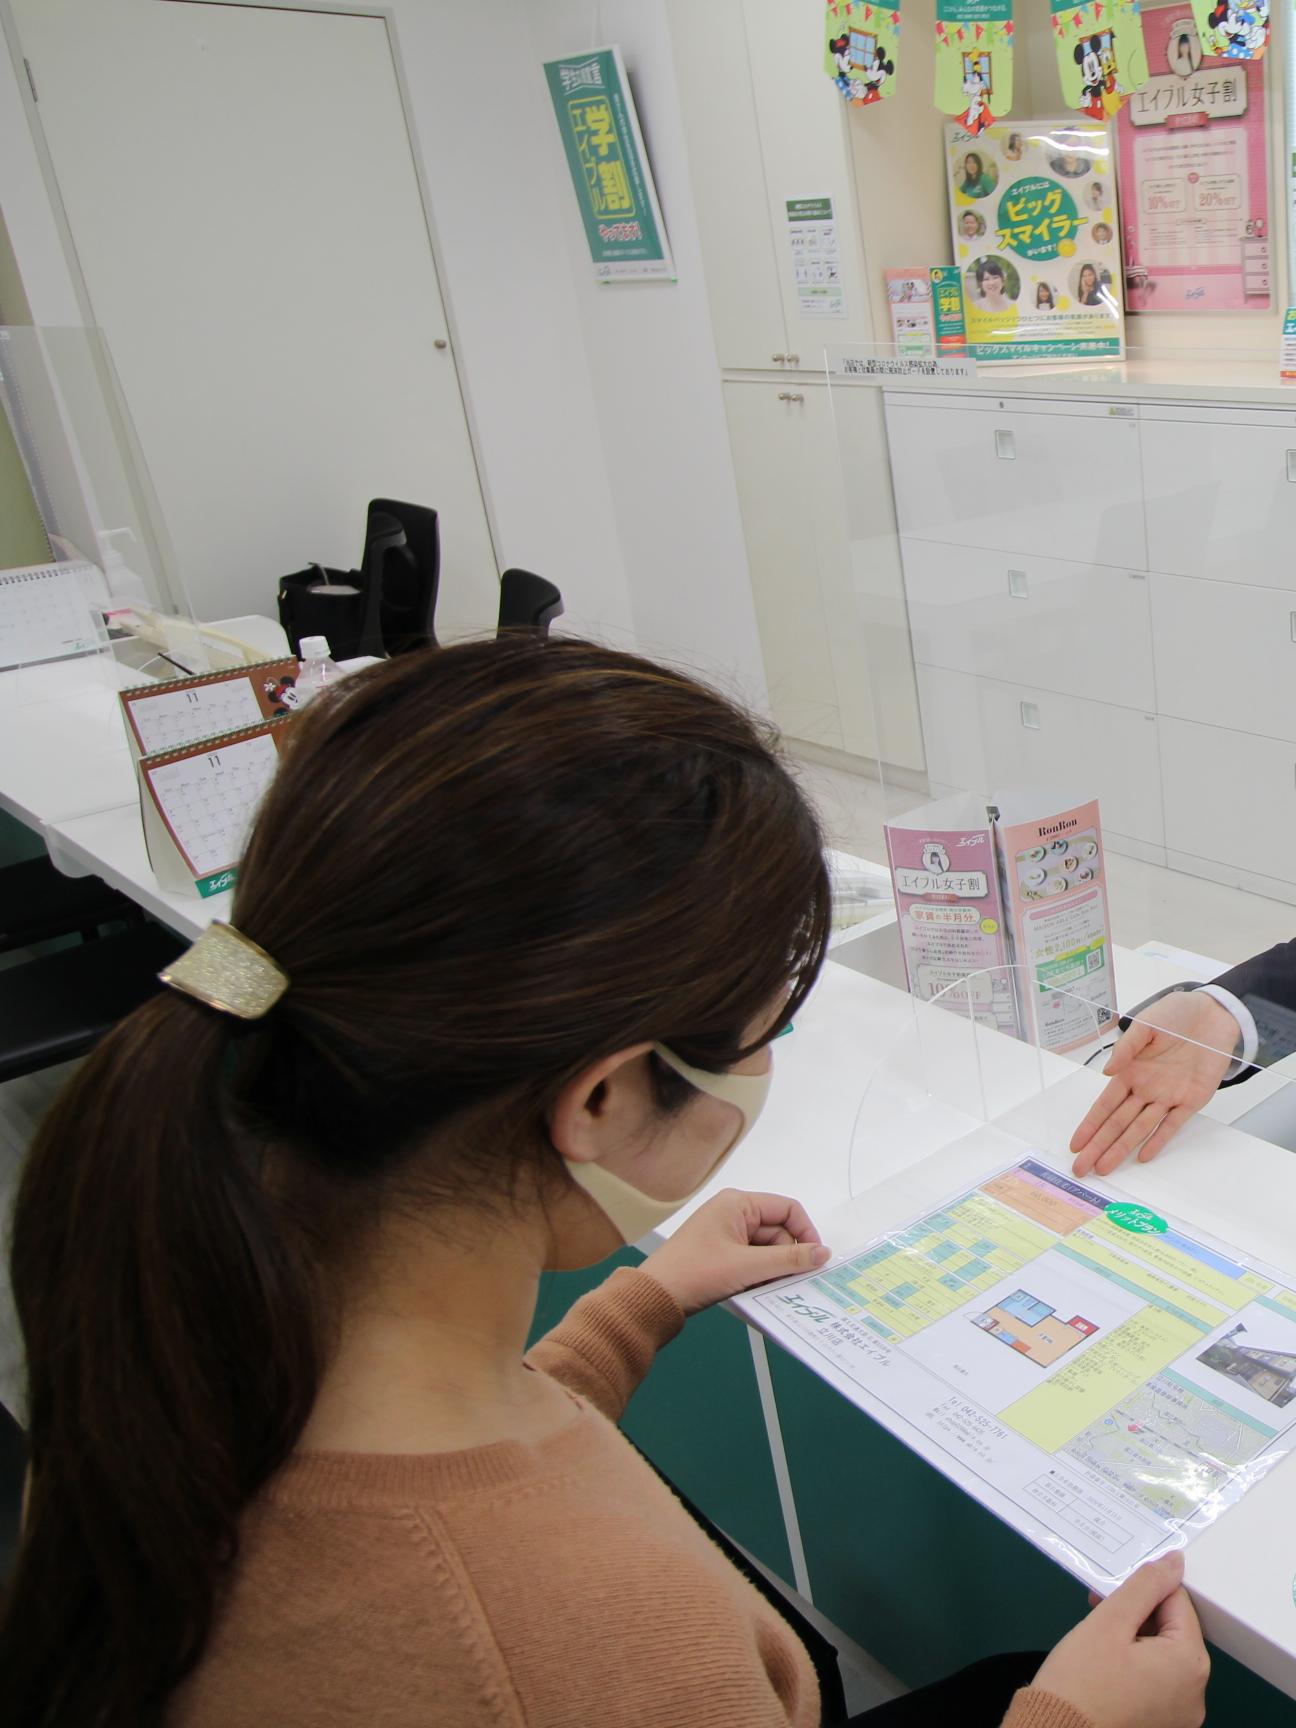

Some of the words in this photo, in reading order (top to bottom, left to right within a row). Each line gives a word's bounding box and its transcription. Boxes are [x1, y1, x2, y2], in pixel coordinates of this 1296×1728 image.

[1137, 79, 1238, 113] エイブル女子割
[571, 108, 606, 211] エイブル
[585, 103, 629, 210] 学割
[1006, 189, 1064, 223] ビッグ
[995, 214, 1090, 251] スマイラー
[208, 754, 222, 769] 11
[955, 833, 985, 848] エイブル
[902, 875, 980, 892] エイブル女子割
[1109, 1208, 1162, 1235] メリットプラン
[776, 1294, 835, 1323] エイブル
